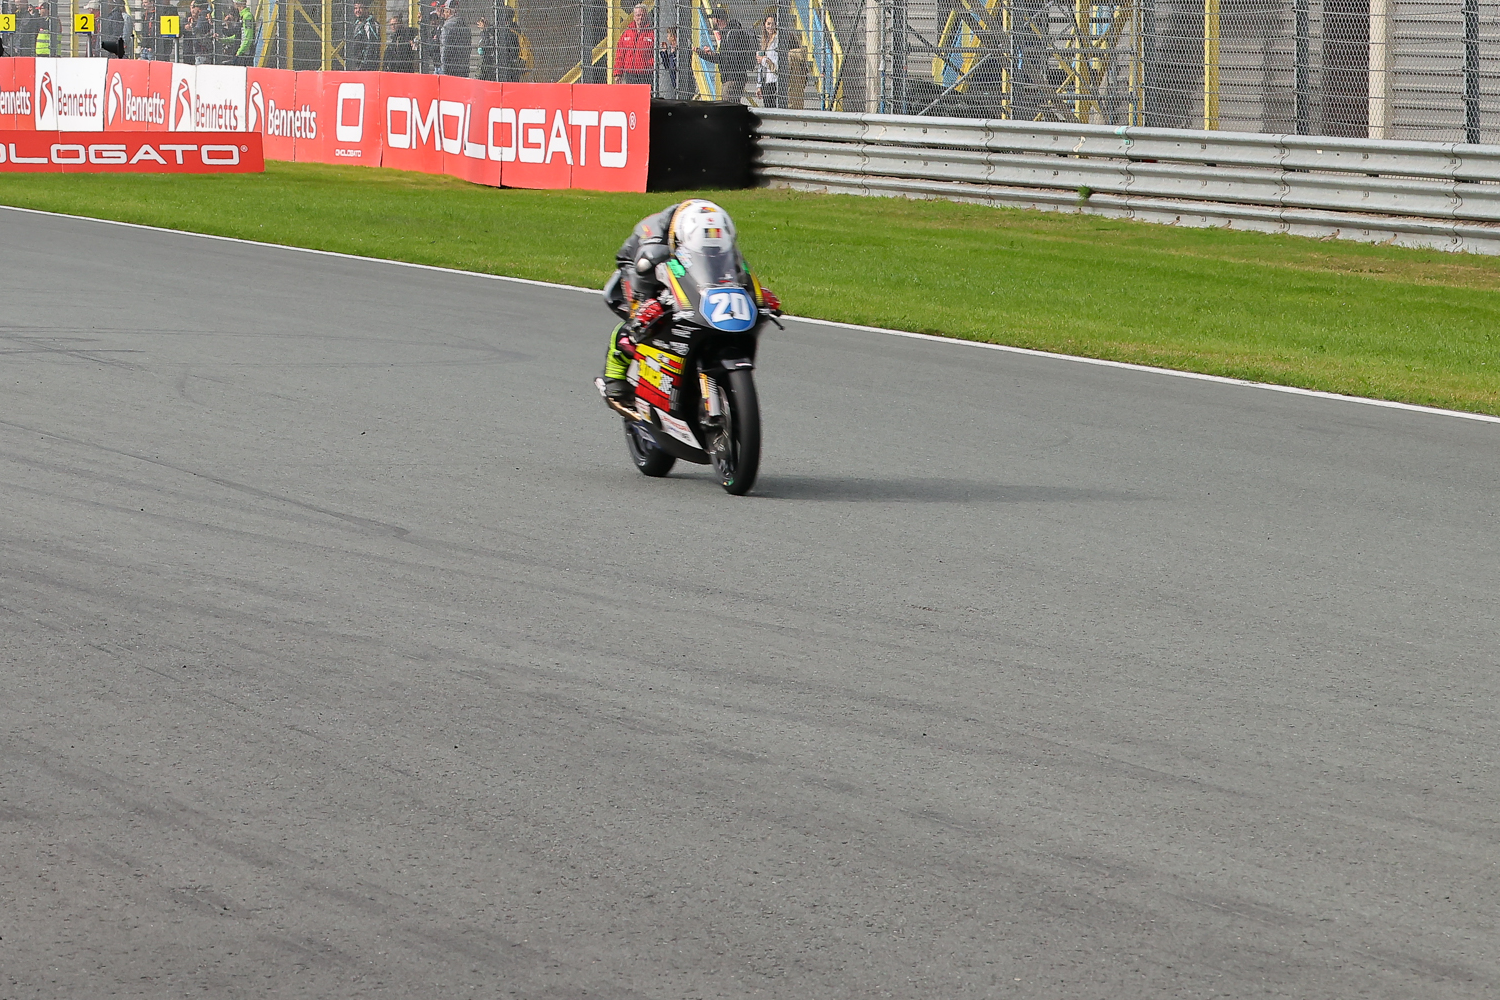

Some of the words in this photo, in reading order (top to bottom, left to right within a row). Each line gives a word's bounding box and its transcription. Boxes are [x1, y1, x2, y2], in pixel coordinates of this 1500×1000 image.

[3, 17, 10, 30] 3
[80, 16, 89, 30] 2
[166, 18, 172, 33] 1
[58, 86, 97, 117] Bennetts
[125, 87, 165, 125] Bennetts
[196, 94, 238, 131] Bennetts
[267, 99, 317, 140] Bennetts
[708, 292, 751, 323] 20
